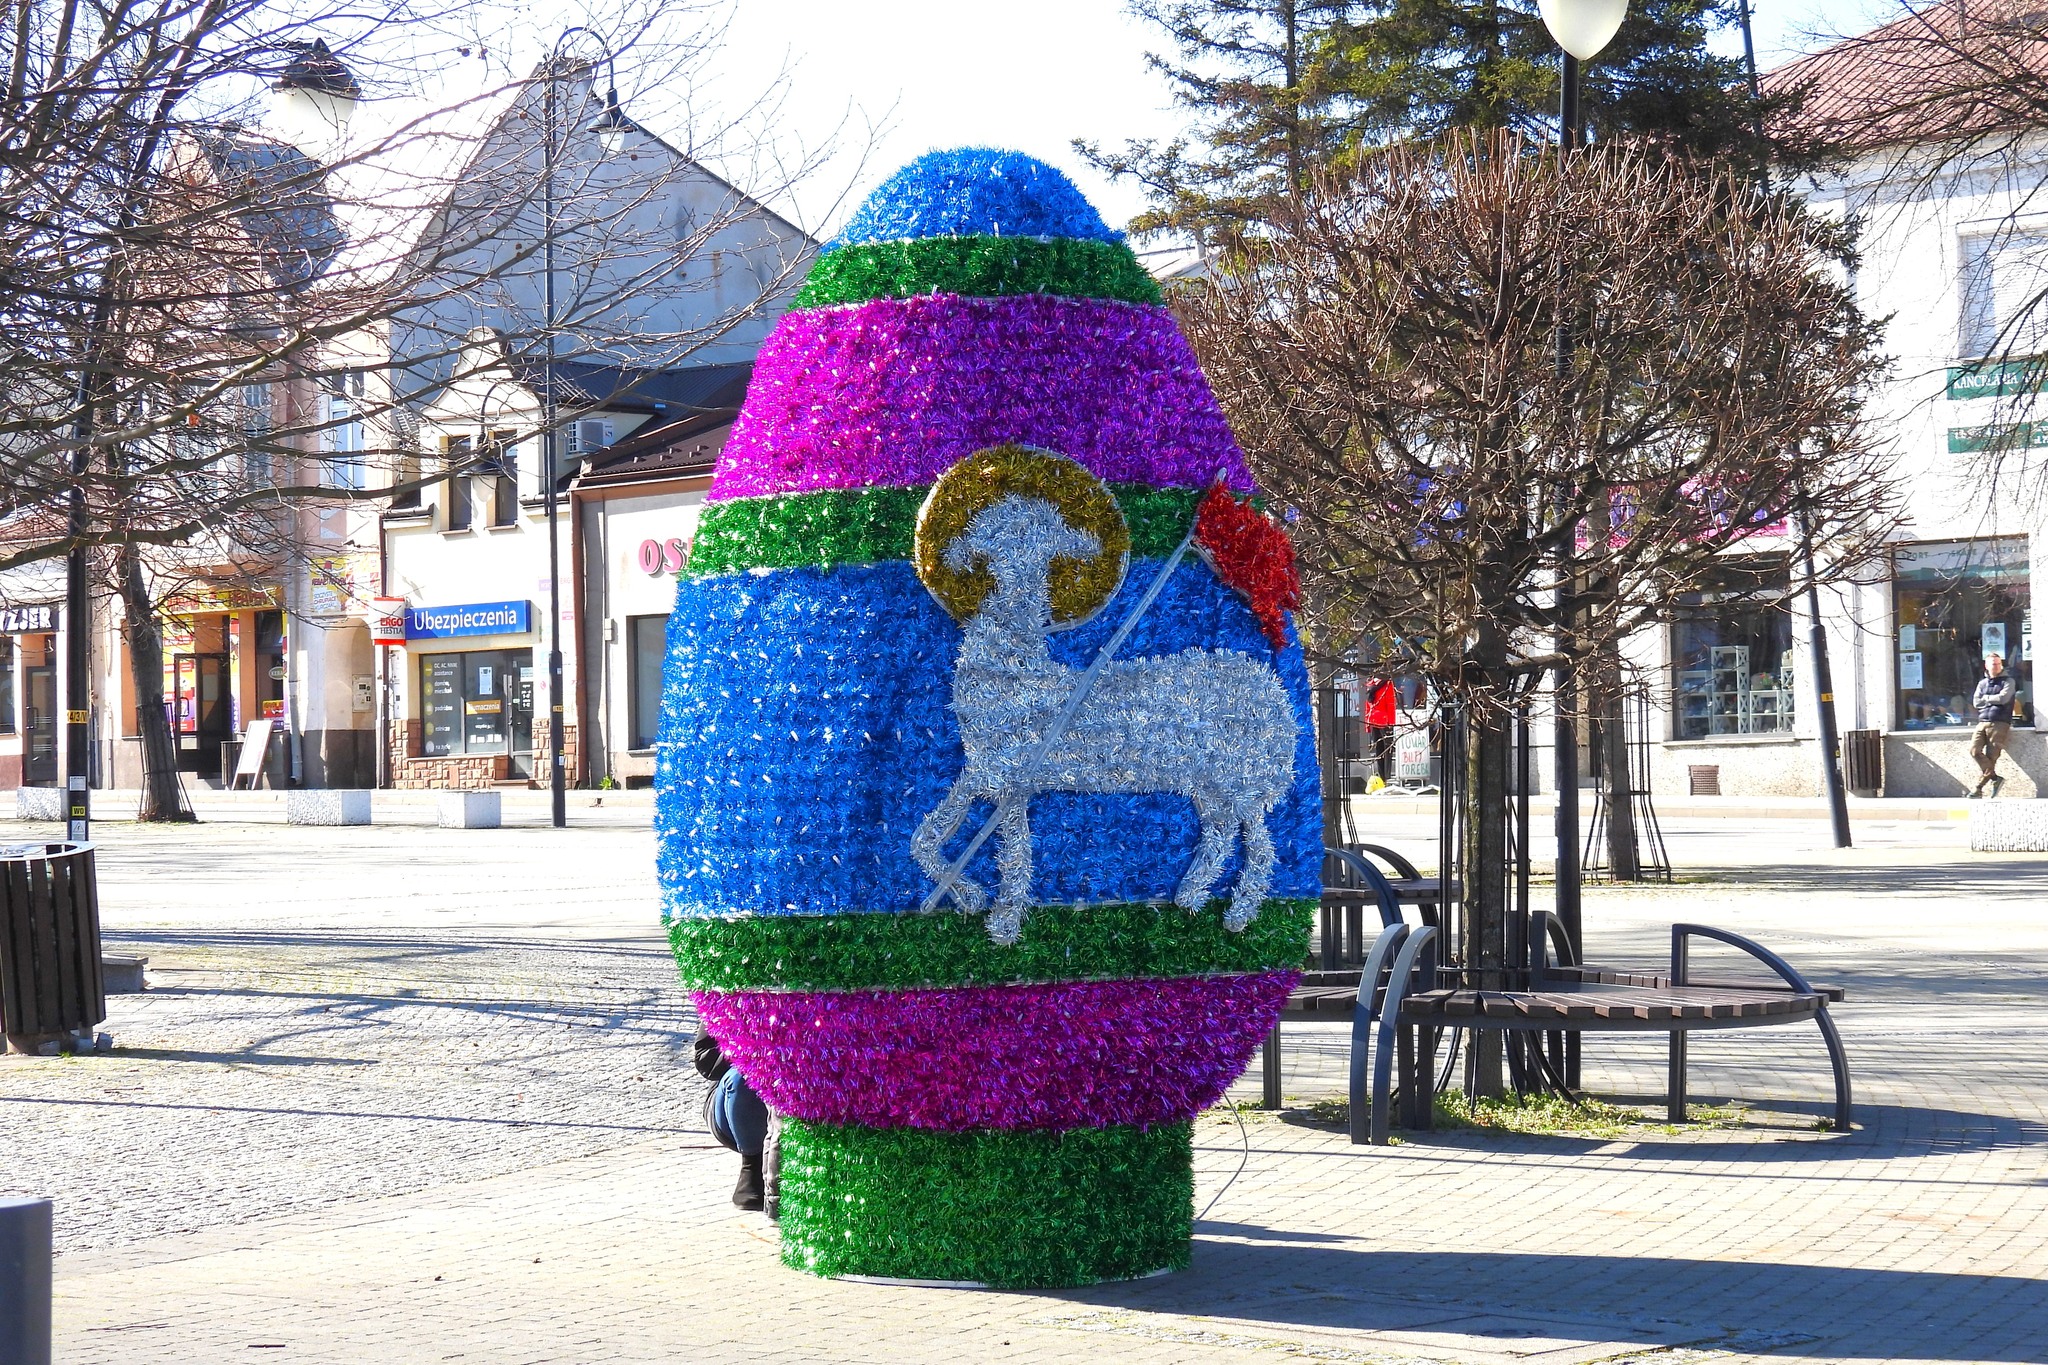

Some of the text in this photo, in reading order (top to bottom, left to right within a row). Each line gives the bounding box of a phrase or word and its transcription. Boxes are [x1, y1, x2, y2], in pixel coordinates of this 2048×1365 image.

[638, 537, 694, 578] OS
[380, 617, 403, 626] ERGO
[414, 605, 517, 634] Ubezpieczenia
[1401, 736, 1426, 749] TOWAR
